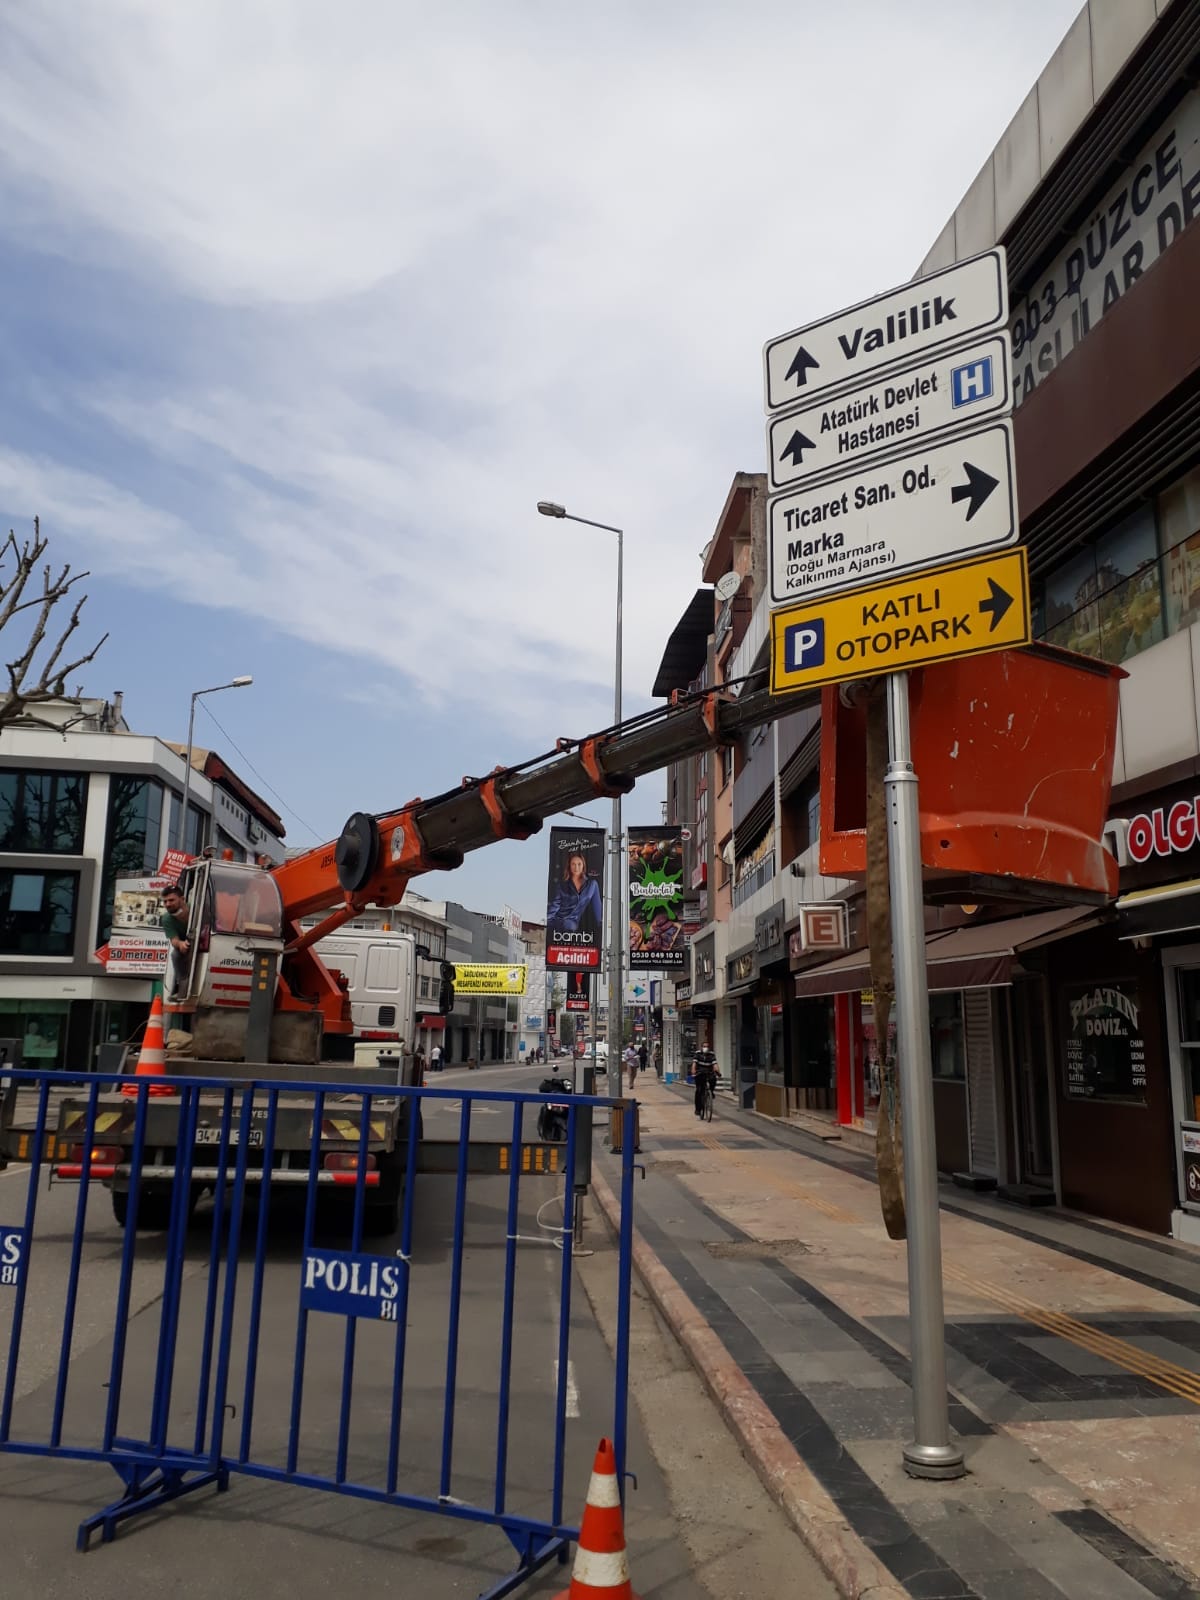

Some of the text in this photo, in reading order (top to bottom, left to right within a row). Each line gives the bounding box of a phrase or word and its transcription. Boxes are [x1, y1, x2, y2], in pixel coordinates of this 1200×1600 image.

[1066, 128, 1180, 297] DÜZCE
[837, 296, 957, 360] Valilik
[960, 361, 990, 401] H
[820, 372, 938, 434] Atatürk Devlet
[838, 406, 920, 453] Hastanesi
[783, 464, 936, 532] Ticaret San. Od.
[786, 540, 886, 576] (Doğu Marmara
[787, 531, 844, 562] Marka
[786, 549, 896, 590] Kalkınma Ajansı)
[862, 589, 940, 626] KATLI
[794, 629, 818, 666] P
[836, 614, 972, 661] OTOPARK
[553, 930, 594, 943] bambi
[812, 916, 834, 941] E
[110, 949, 122, 959] 50
[125, 950, 153, 960] metre
[557, 952, 590, 965] Açıldı!
[1070, 985, 1138, 1031] PLATİN
[1086, 1012, 1121, 1036] DÖVİZ
[197, 1130, 210, 1142] 34
[1, 1265, 19, 1285] 81
[304, 1256, 399, 1300] POLİS
[381, 1299, 398, 1321] 81
